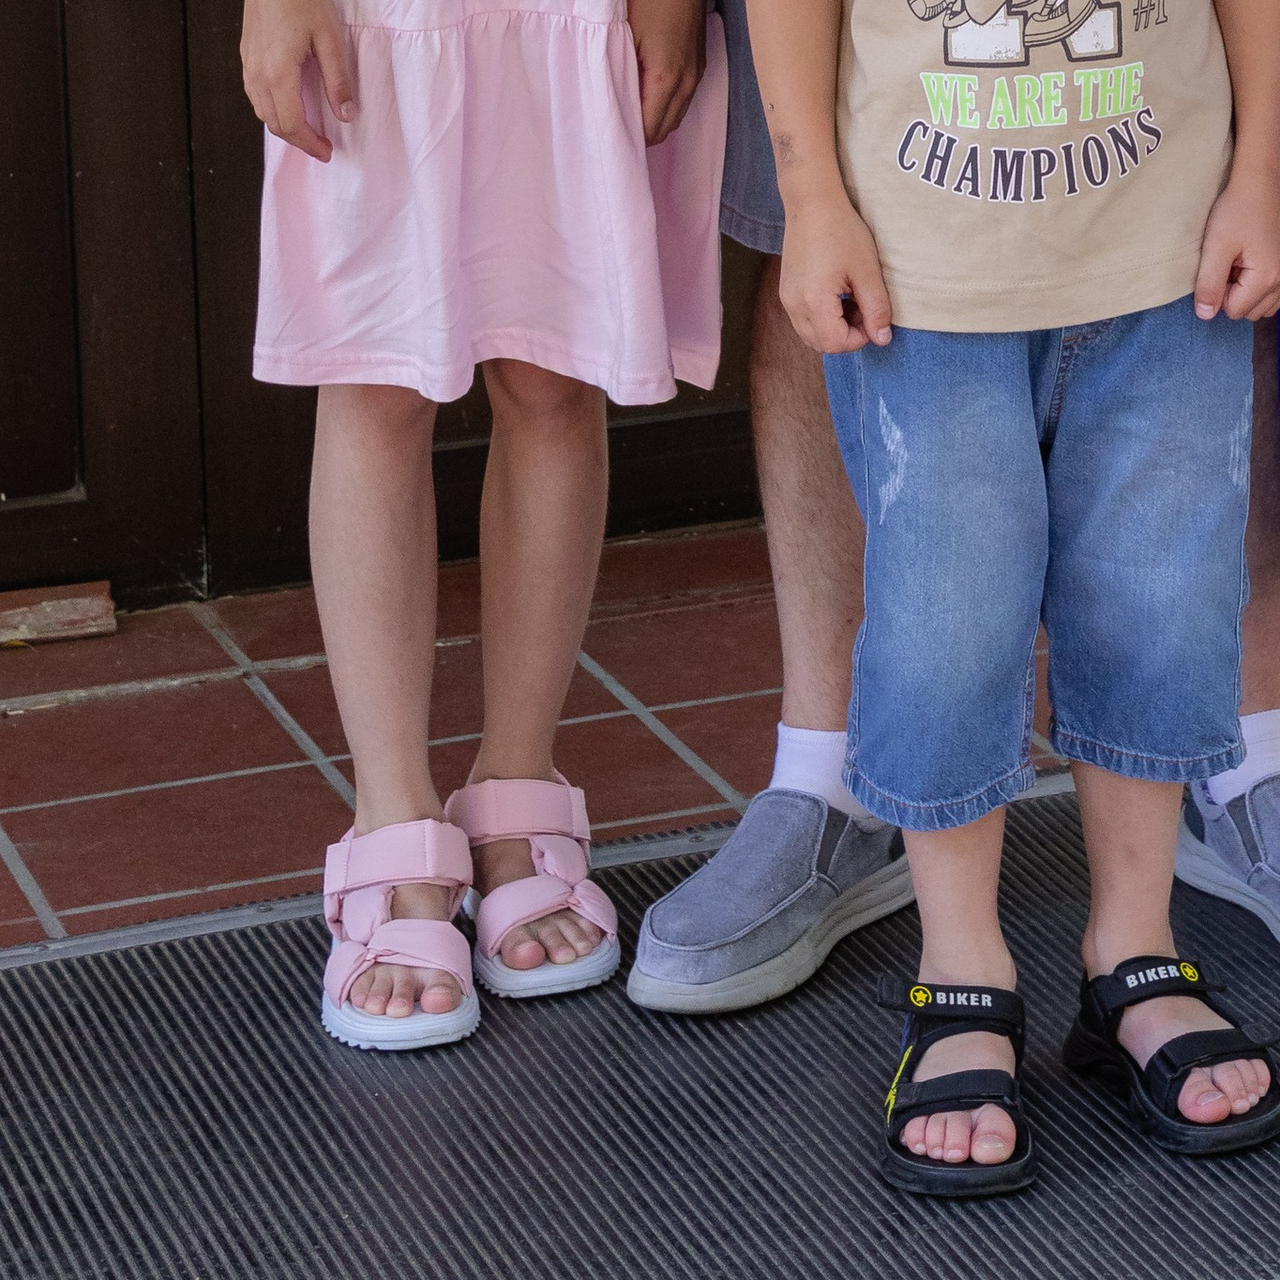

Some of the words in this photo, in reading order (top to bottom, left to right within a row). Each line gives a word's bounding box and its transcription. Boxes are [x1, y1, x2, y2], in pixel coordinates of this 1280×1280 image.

[920, 72, 980, 128] WE
[987, 72, 1067, 129] ARE
[1074, 61, 1145, 121] THE
[896, 107, 1163, 204] CHAMPIONS
[935, 991, 993, 1008] BIKER
[1125, 965, 1180, 989] BIKER
